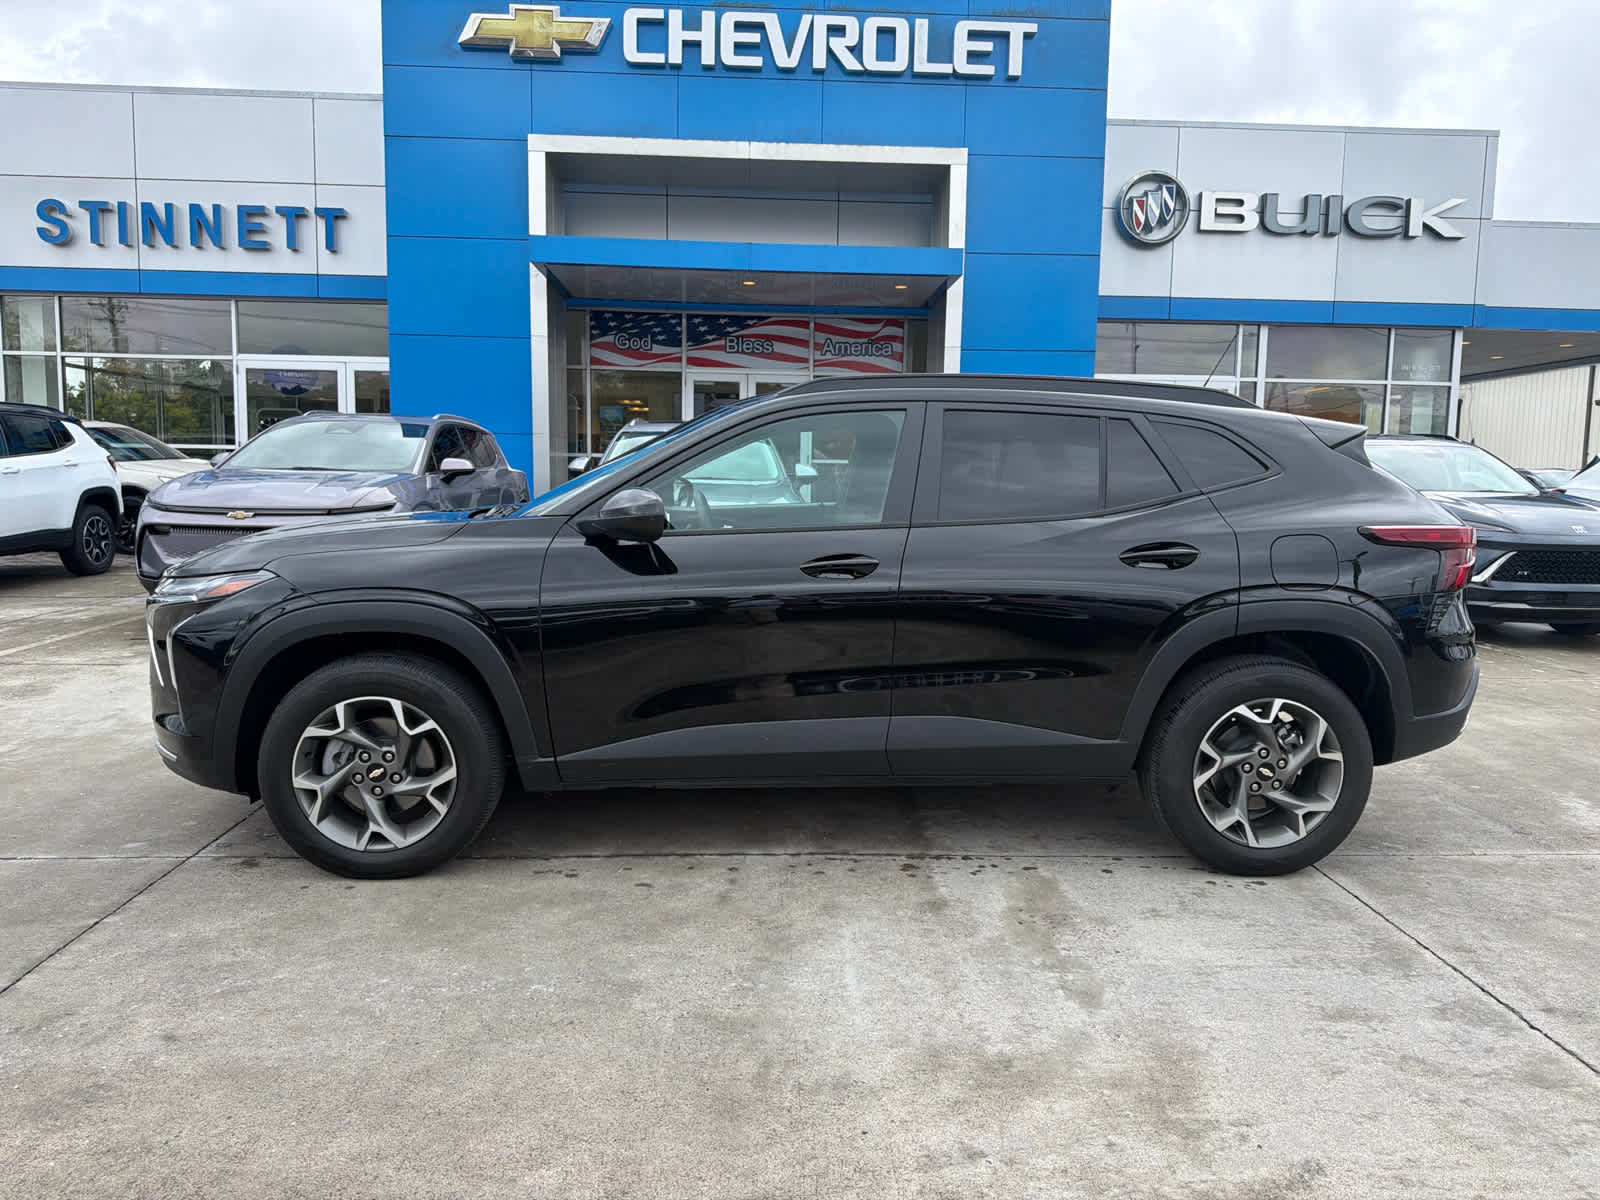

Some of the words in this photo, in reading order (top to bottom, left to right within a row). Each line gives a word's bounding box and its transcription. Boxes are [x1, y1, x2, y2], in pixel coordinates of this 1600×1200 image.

[622, 7, 1039, 79] CHEVROLET
[36, 198, 347, 252] STINNETT
[1198, 191, 1468, 240] BUICK
[614, 332, 653, 351] God
[724, 336, 775, 354] Bless
[821, 338, 893, 357] America
